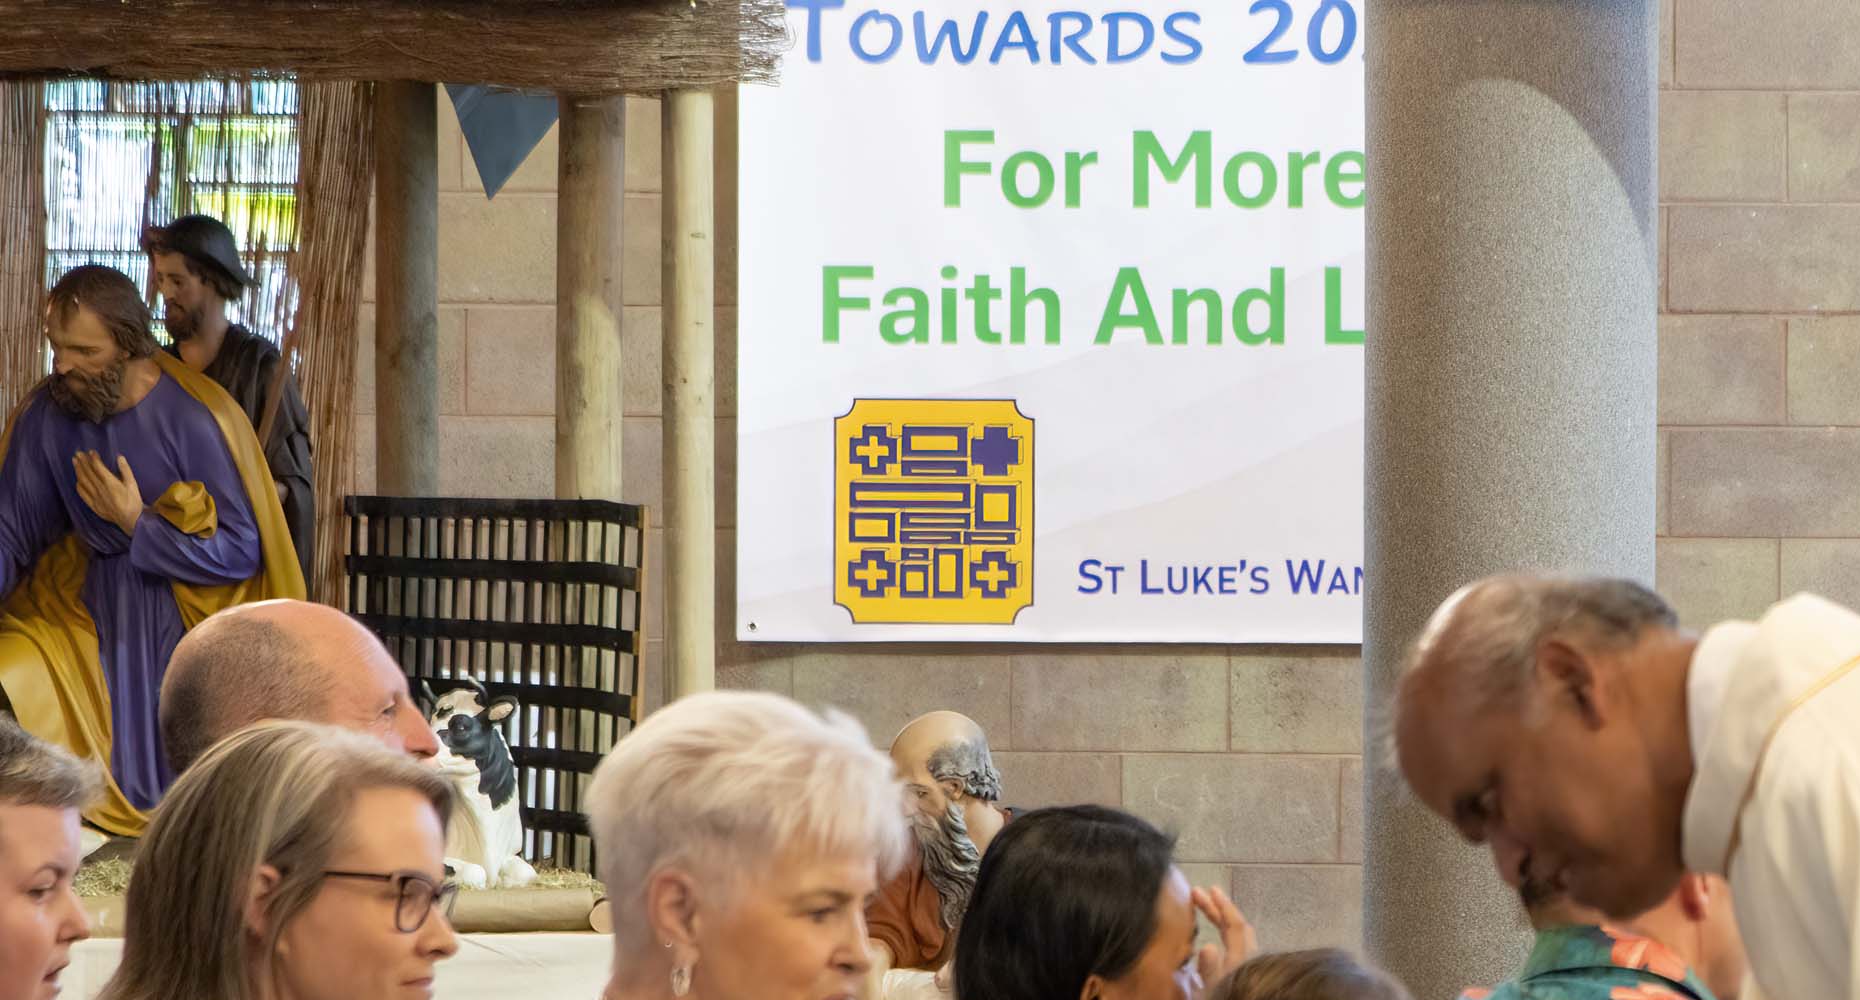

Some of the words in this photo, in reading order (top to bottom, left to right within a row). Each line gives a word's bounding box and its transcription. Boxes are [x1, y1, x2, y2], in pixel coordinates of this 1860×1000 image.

[784, 0, 1203, 64] TOWARDS
[1243, 0, 1364, 64] 20
[945, 130, 1098, 208] For
[1132, 130, 1365, 209] More
[822, 266, 1061, 344] Faith
[1094, 267, 1285, 345] And
